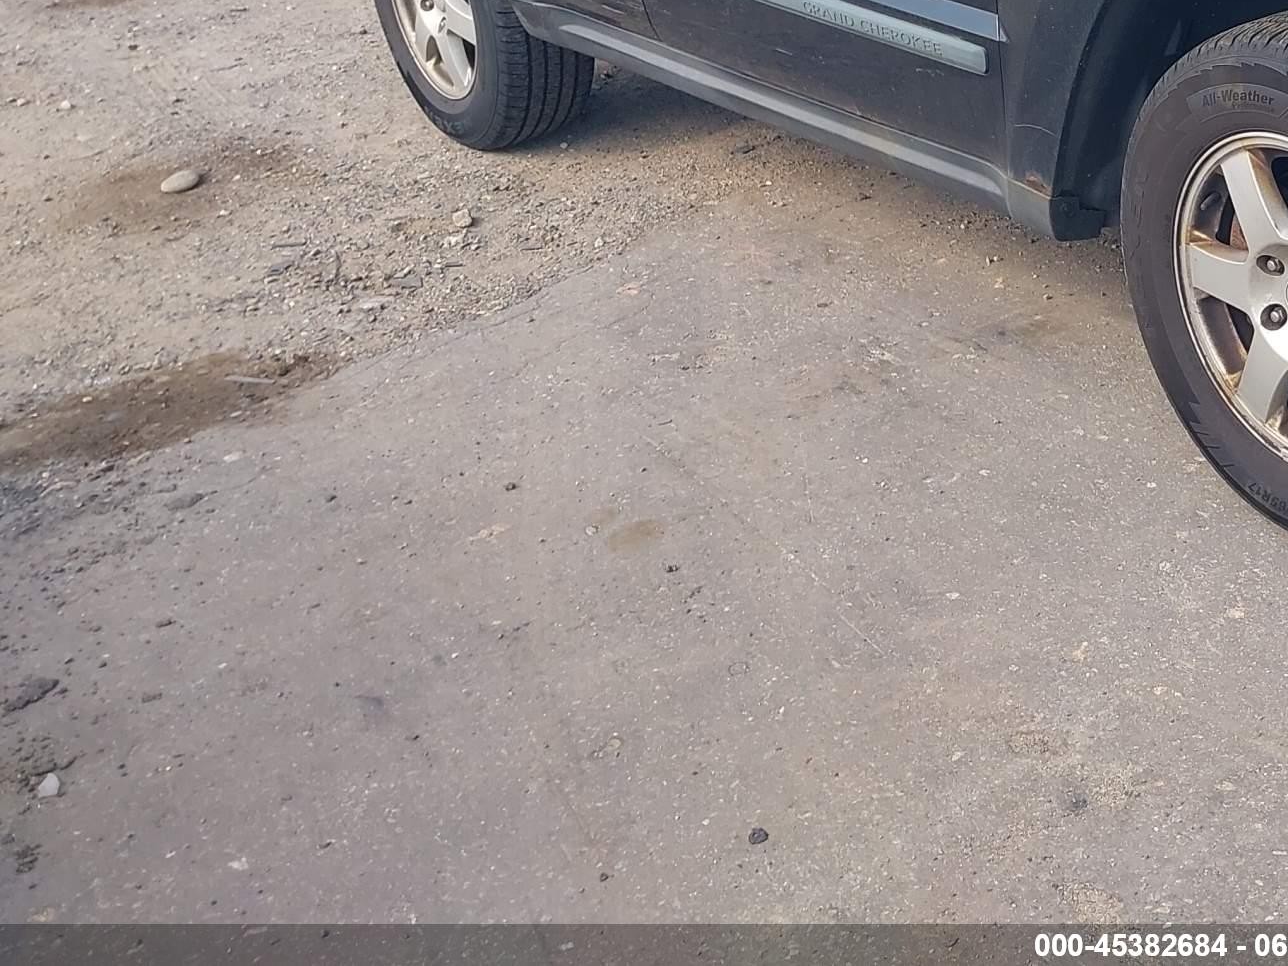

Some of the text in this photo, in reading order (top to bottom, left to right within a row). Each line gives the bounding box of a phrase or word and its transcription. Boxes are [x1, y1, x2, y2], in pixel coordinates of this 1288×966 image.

[802, 0, 944, 58] GRAND CHEROKEE
[1202, 89, 1275, 107] All-Weather
